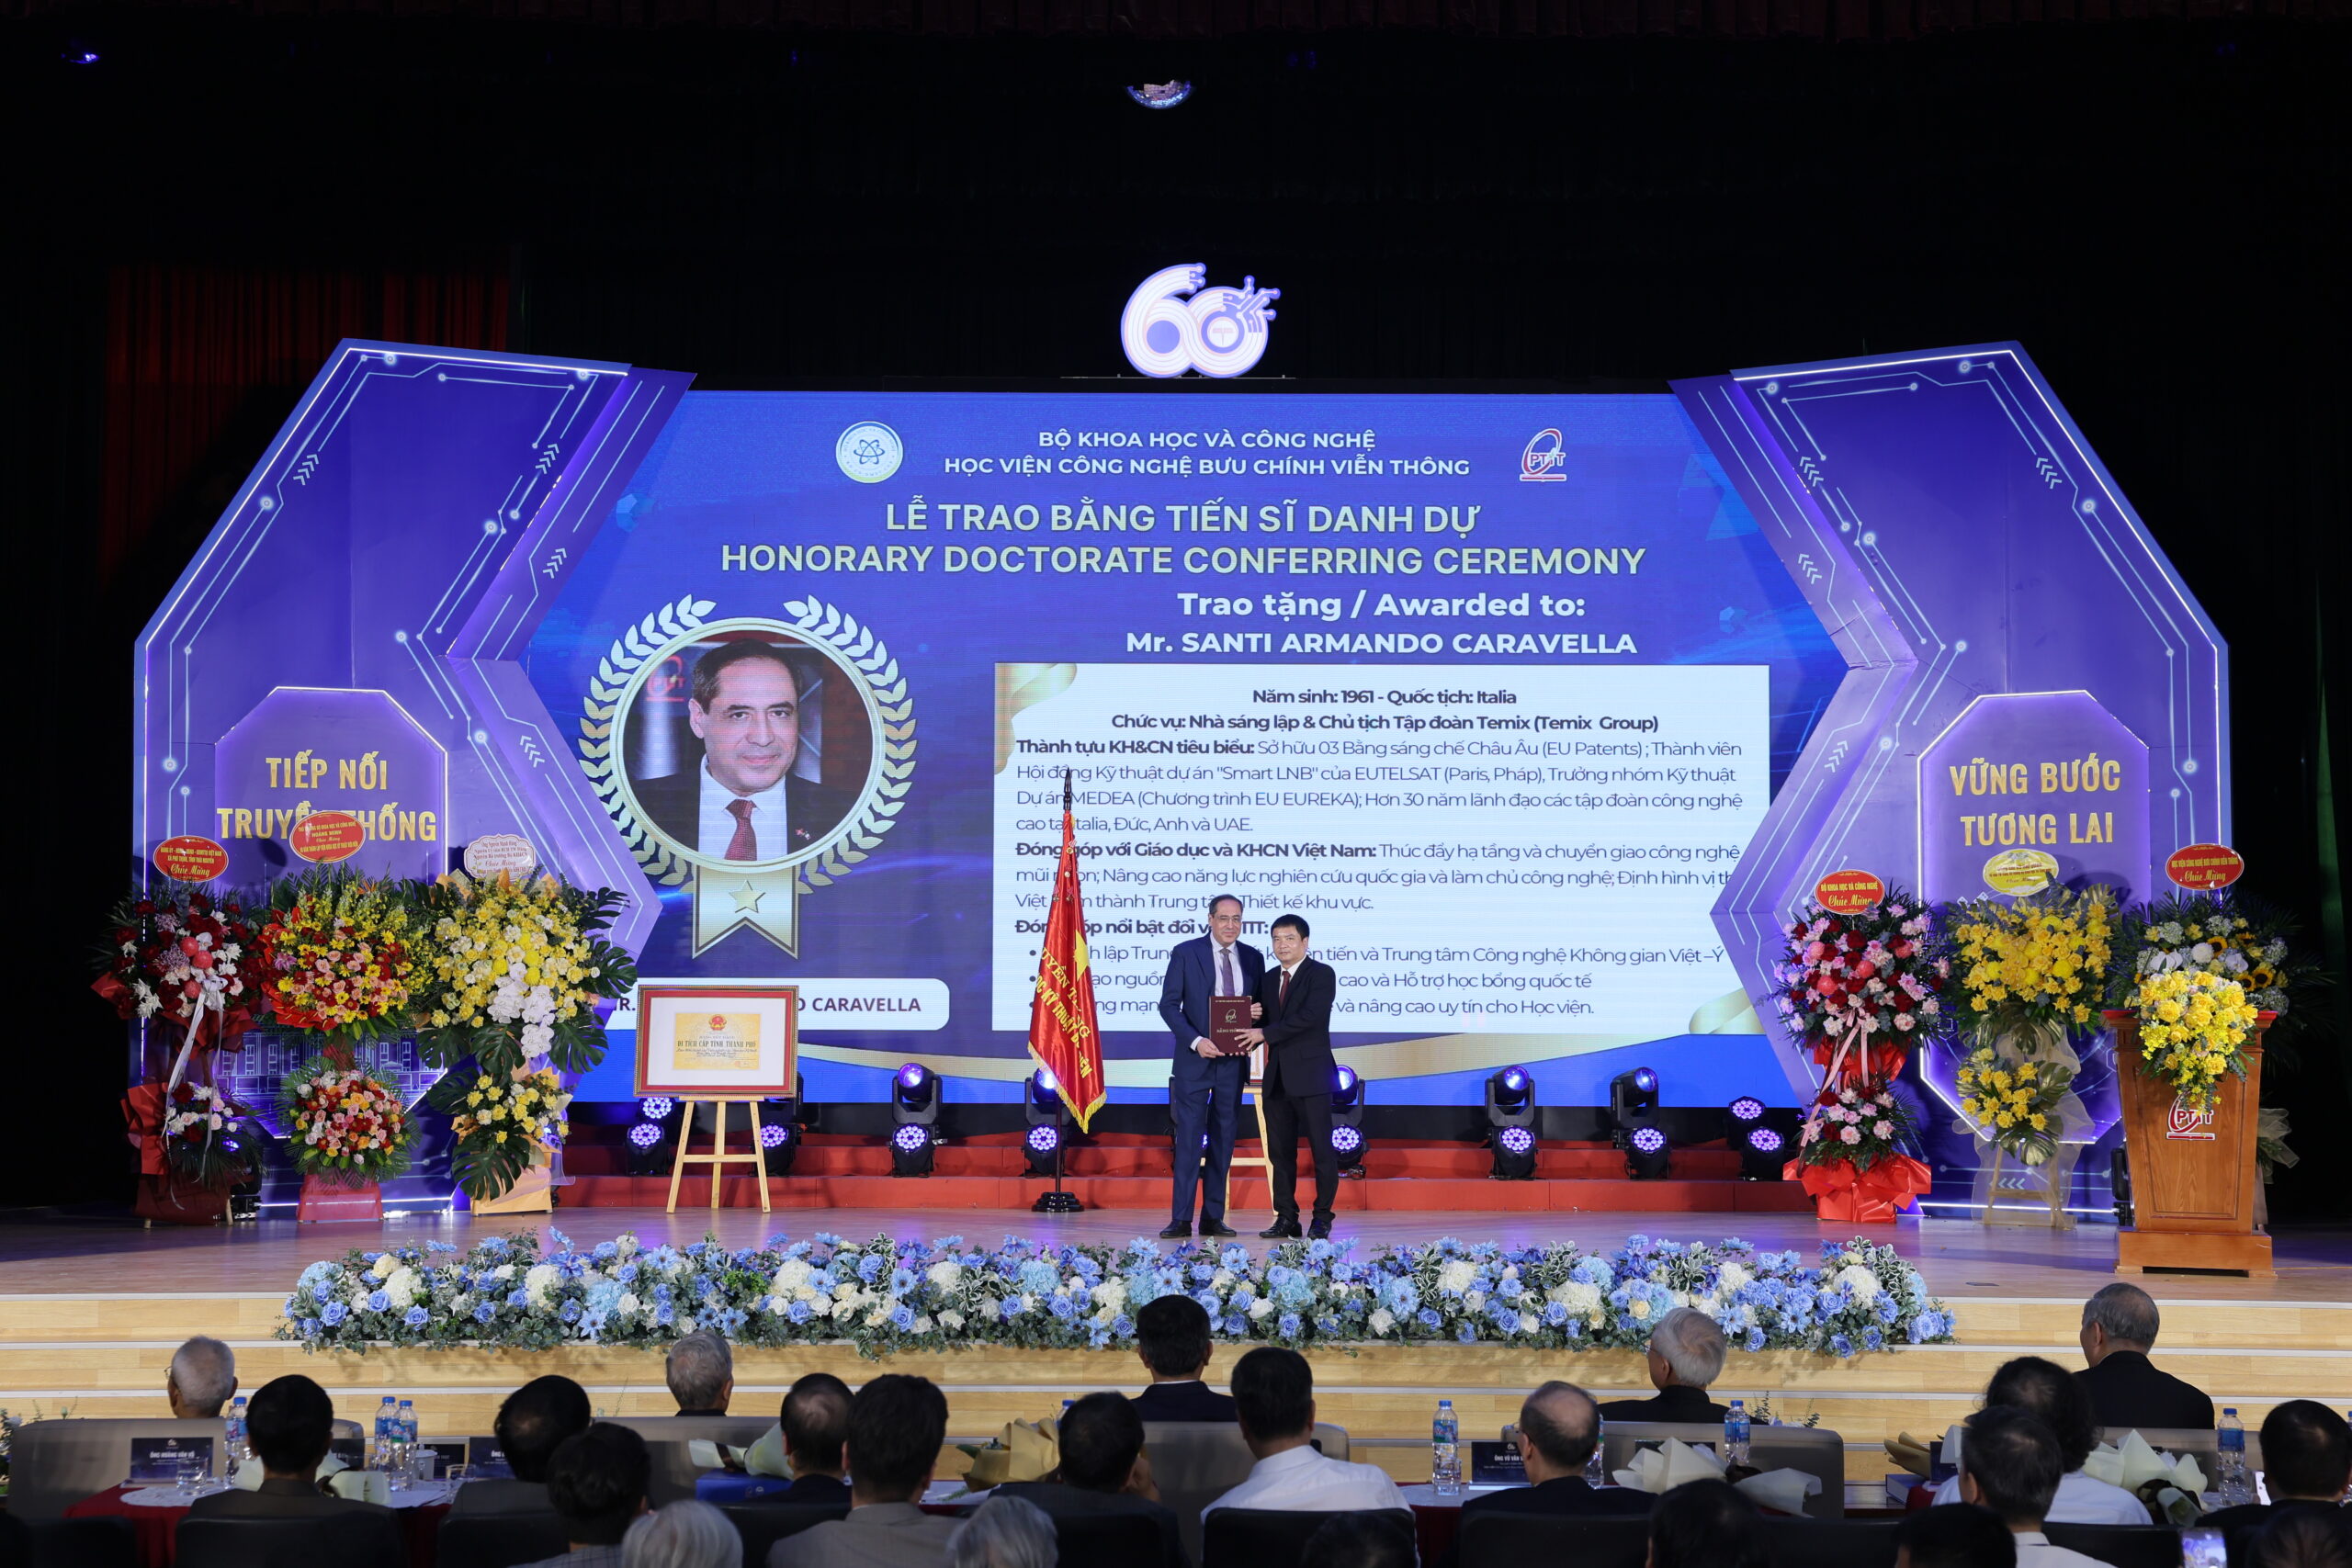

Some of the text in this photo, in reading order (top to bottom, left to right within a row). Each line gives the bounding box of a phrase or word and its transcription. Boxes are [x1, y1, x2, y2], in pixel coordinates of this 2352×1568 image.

[1039, 428, 1375, 452] BỘ KHOA HỌC VÀ CÔNG NGHỆ
[944, 453, 1469, 478] HỌC VIỆN CÔNG NGHỆ BƯU CHÍNH VIỄN THÔNG
[888, 494, 1481, 538] LỄ TRAO BẰNG TIẾN SĨ DANH DỰ
[722, 545, 1645, 574] HONORARY DOCTORATE CONFERRING CEREMONY
[1177, 590, 1585, 622] Trao tặng / Awarded to:
[1126, 632, 1637, 654] Mr. SANTI ARMANDO CARAVELLA
[1253, 689, 1295, 704] Năm
[1297, 688, 1339, 704] sinh:
[1340, 690, 1374, 704] 1961
[1386, 688, 1434, 706] Quốc
[1437, 689, 1474, 707] tịch:
[1476, 689, 1517, 704] Italia
[1112, 713, 1659, 733] Chức vụ: Nhà sáng lập & Chủ tịch Tập đoàn Temix (Temix Group)
[1015, 739, 1072, 753] Thành
[1074, 740, 1105, 757] tựu
[1109, 740, 1173, 754] KH&CN
[1176, 739, 1210, 754] tiêu
[1213, 739, 1255, 754] biểu:
[1258, 739, 1279, 754] Sở
[1282, 740, 1316, 755] hữu
[1318, 740, 1340, 755] 03
[1342, 739, 1387, 758] Bằng
[1390, 740, 1430, 759] sáng
[1433, 740, 1464, 755] chế
[1467, 740, 1512, 755] Châu
[1514, 739, 1539, 755] Âu
[1543, 741, 1571, 759] (EU
[1575, 741, 1643, 759] Patents)
[1650, 741, 1705, 756] Thành
[1707, 741, 1742, 756] viên
[266, 750, 387, 790] TIẾP NỐI
[1949, 753, 2120, 795] VỮNG BƯỚC
[1016, 790, 1044, 807] Dự
[1072, 791, 1136, 806] MEDEA
[1137, 791, 1210, 809] (Chương
[1213, 791, 1251, 806] trình
[1255, 792, 1279, 806] EU
[1283, 792, 1363, 809] EUREKA);
[1365, 793, 1400, 807] Hơn
[1402, 792, 1424, 807] 30
[1427, 793, 1467, 807] năm
[1470, 792, 1506, 807] lãnh
[1509, 792, 1542, 810] đạo
[1544, 793, 1573, 807] các
[1575, 793, 1604, 810] tập
[1605, 793, 1649, 807] đoàn
[1651, 793, 1695, 811] công
[1698, 793, 1743, 811] nghệ
[1960, 812, 2113, 846] TƯƠNG LAI
[1104, 841, 1132, 856] với
[1134, 841, 1174, 857] Giáo
[1176, 842, 1210, 861] dục
[1212, 842, 1233, 857] và
[1237, 843, 1289, 857] KHCN
[1292, 842, 1328, 861] Việt
[1330, 843, 1376, 858] Nam:
[1379, 843, 1421, 858] Thúc
[1423, 842, 1455, 862] đẩy
[1457, 843, 1478, 862] hạ
[1481, 843, 1520, 862] tầng
[1522, 844, 1542, 858] và
[1545, 843, 1607, 862] chuyển
[1610, 844, 1646, 862] giao
[1648, 844, 1691, 863] công
[1695, 844, 1740, 863] nghệ
[1827, 883, 1838, 891] KHOA
[1839, 883, 1848, 892] HỌC
[1855, 882, 1866, 890] CÔNG
[1867, 881, 1878, 892] NGHỆ
[1828, 895, 1848, 907] Chúc
[812, 998, 922, 1012] CARAVELLA
